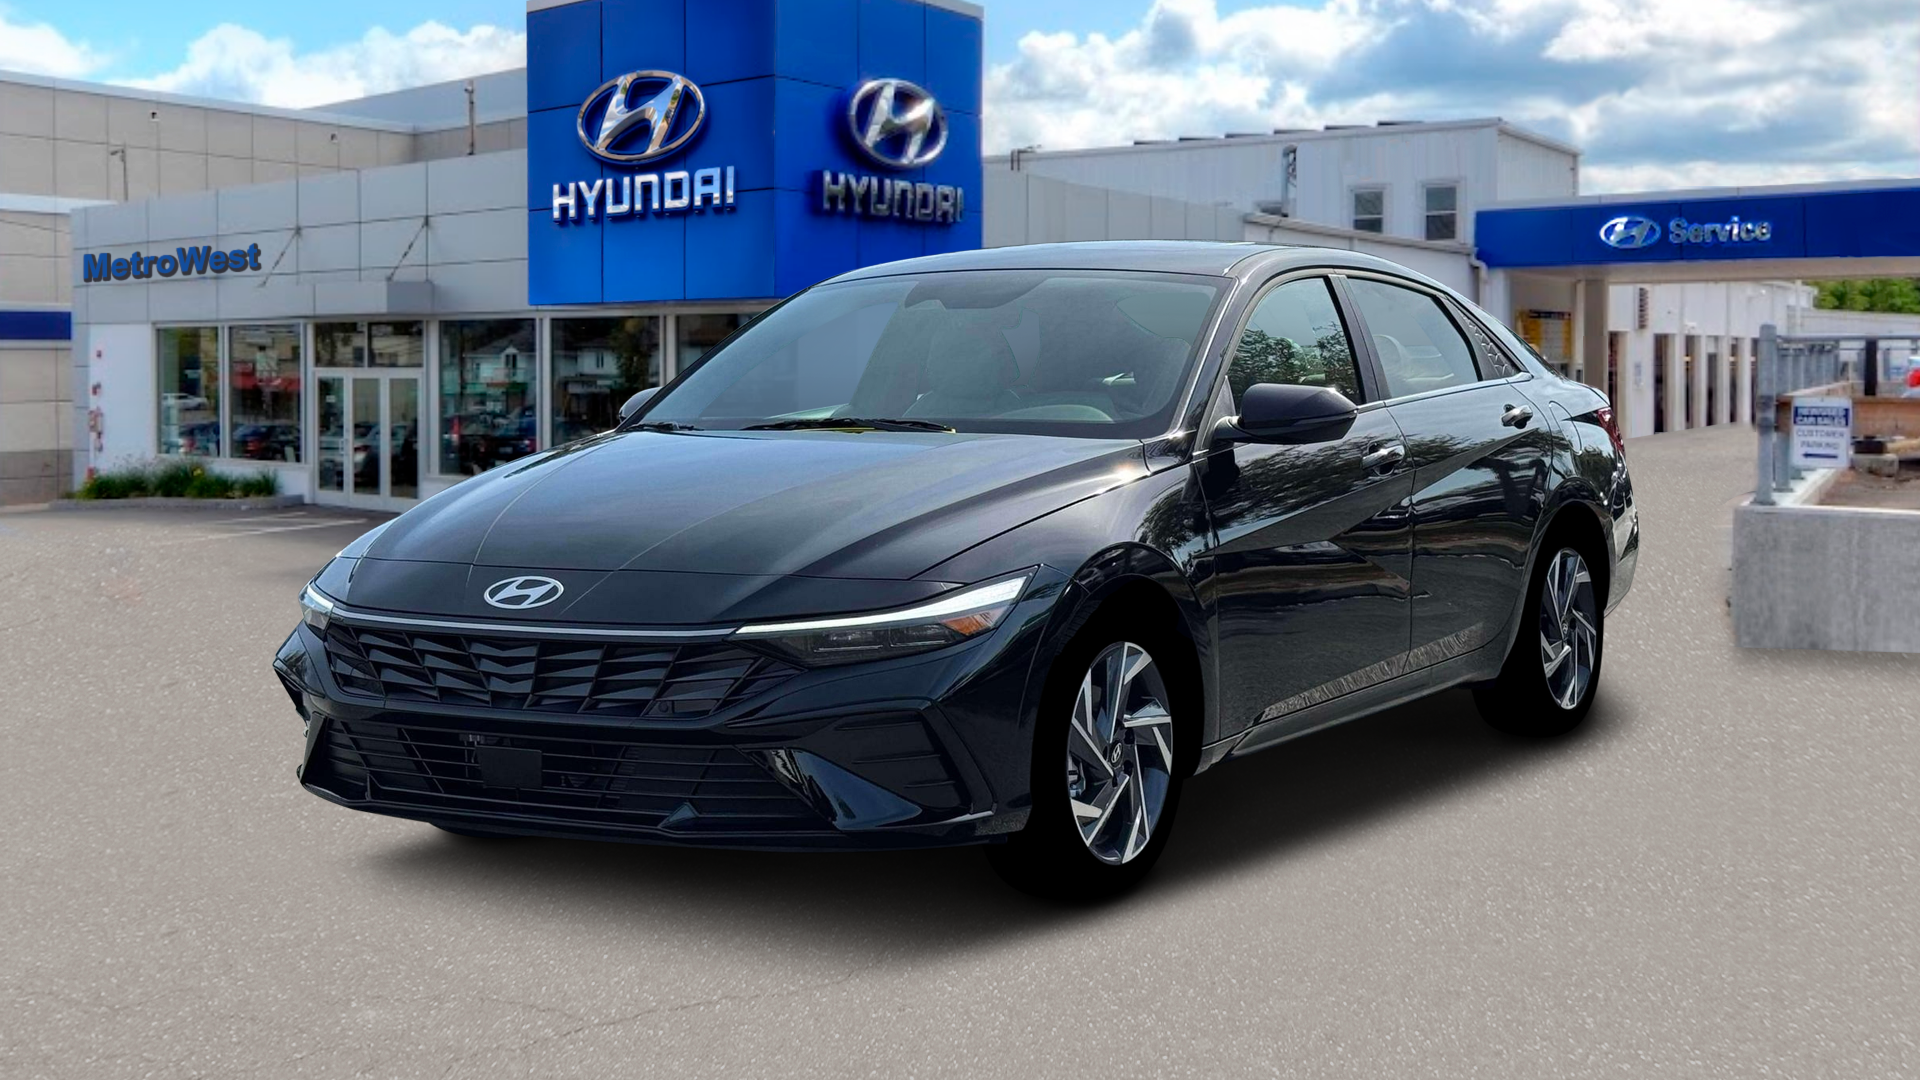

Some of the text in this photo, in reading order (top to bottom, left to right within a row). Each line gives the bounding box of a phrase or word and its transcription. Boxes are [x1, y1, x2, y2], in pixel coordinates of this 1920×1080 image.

[552, 165, 736, 221] HYUNDAI
[822, 169, 965, 224] HYUNDAI
[1668, 215, 1772, 244] Service
[83, 243, 262, 283] MetroWest
[1796, 429, 1845, 439] CUSTOMER
